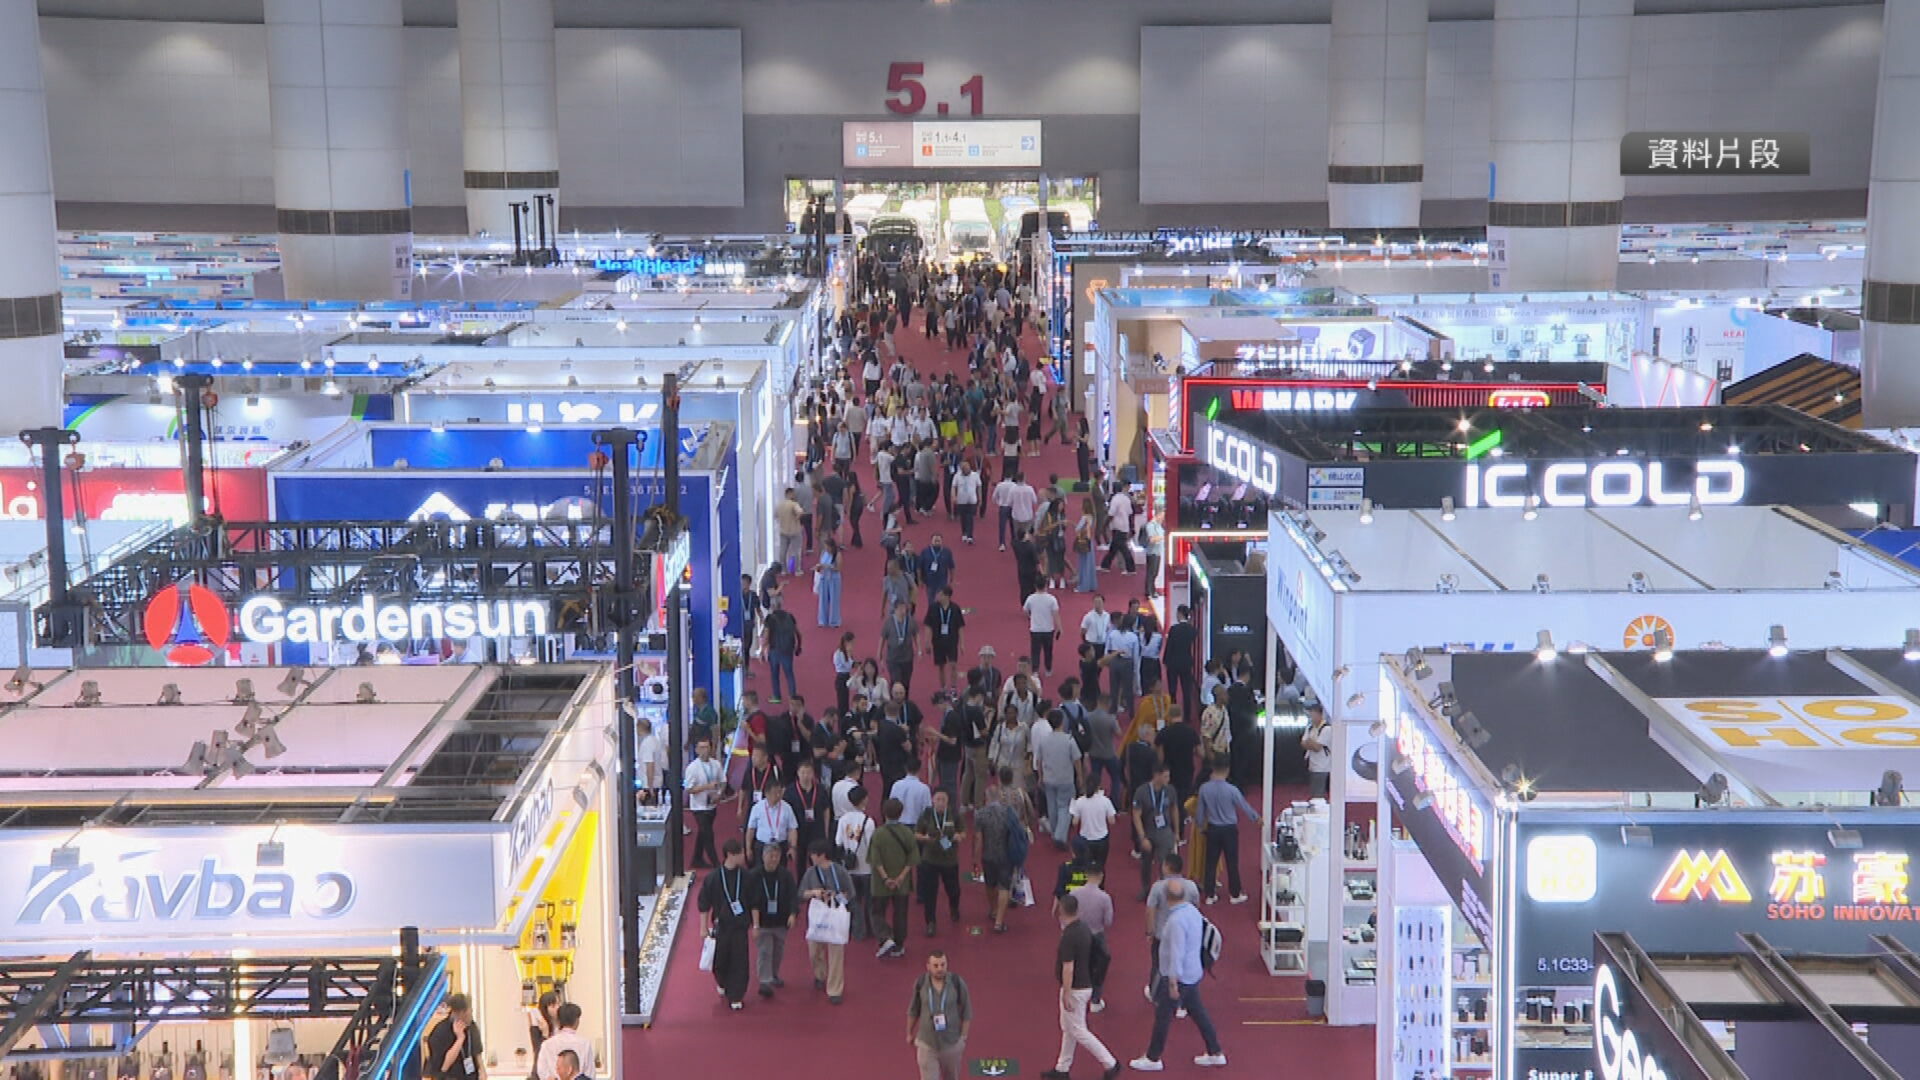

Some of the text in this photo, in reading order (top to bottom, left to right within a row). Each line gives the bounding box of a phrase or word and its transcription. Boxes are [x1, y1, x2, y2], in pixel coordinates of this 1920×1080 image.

[885, 62, 984, 116] 5.1
[240, 594, 547, 643] Gardensun
[1769, 851, 1909, 904] 苏豪
[1767, 903, 1825, 920] SOHO
